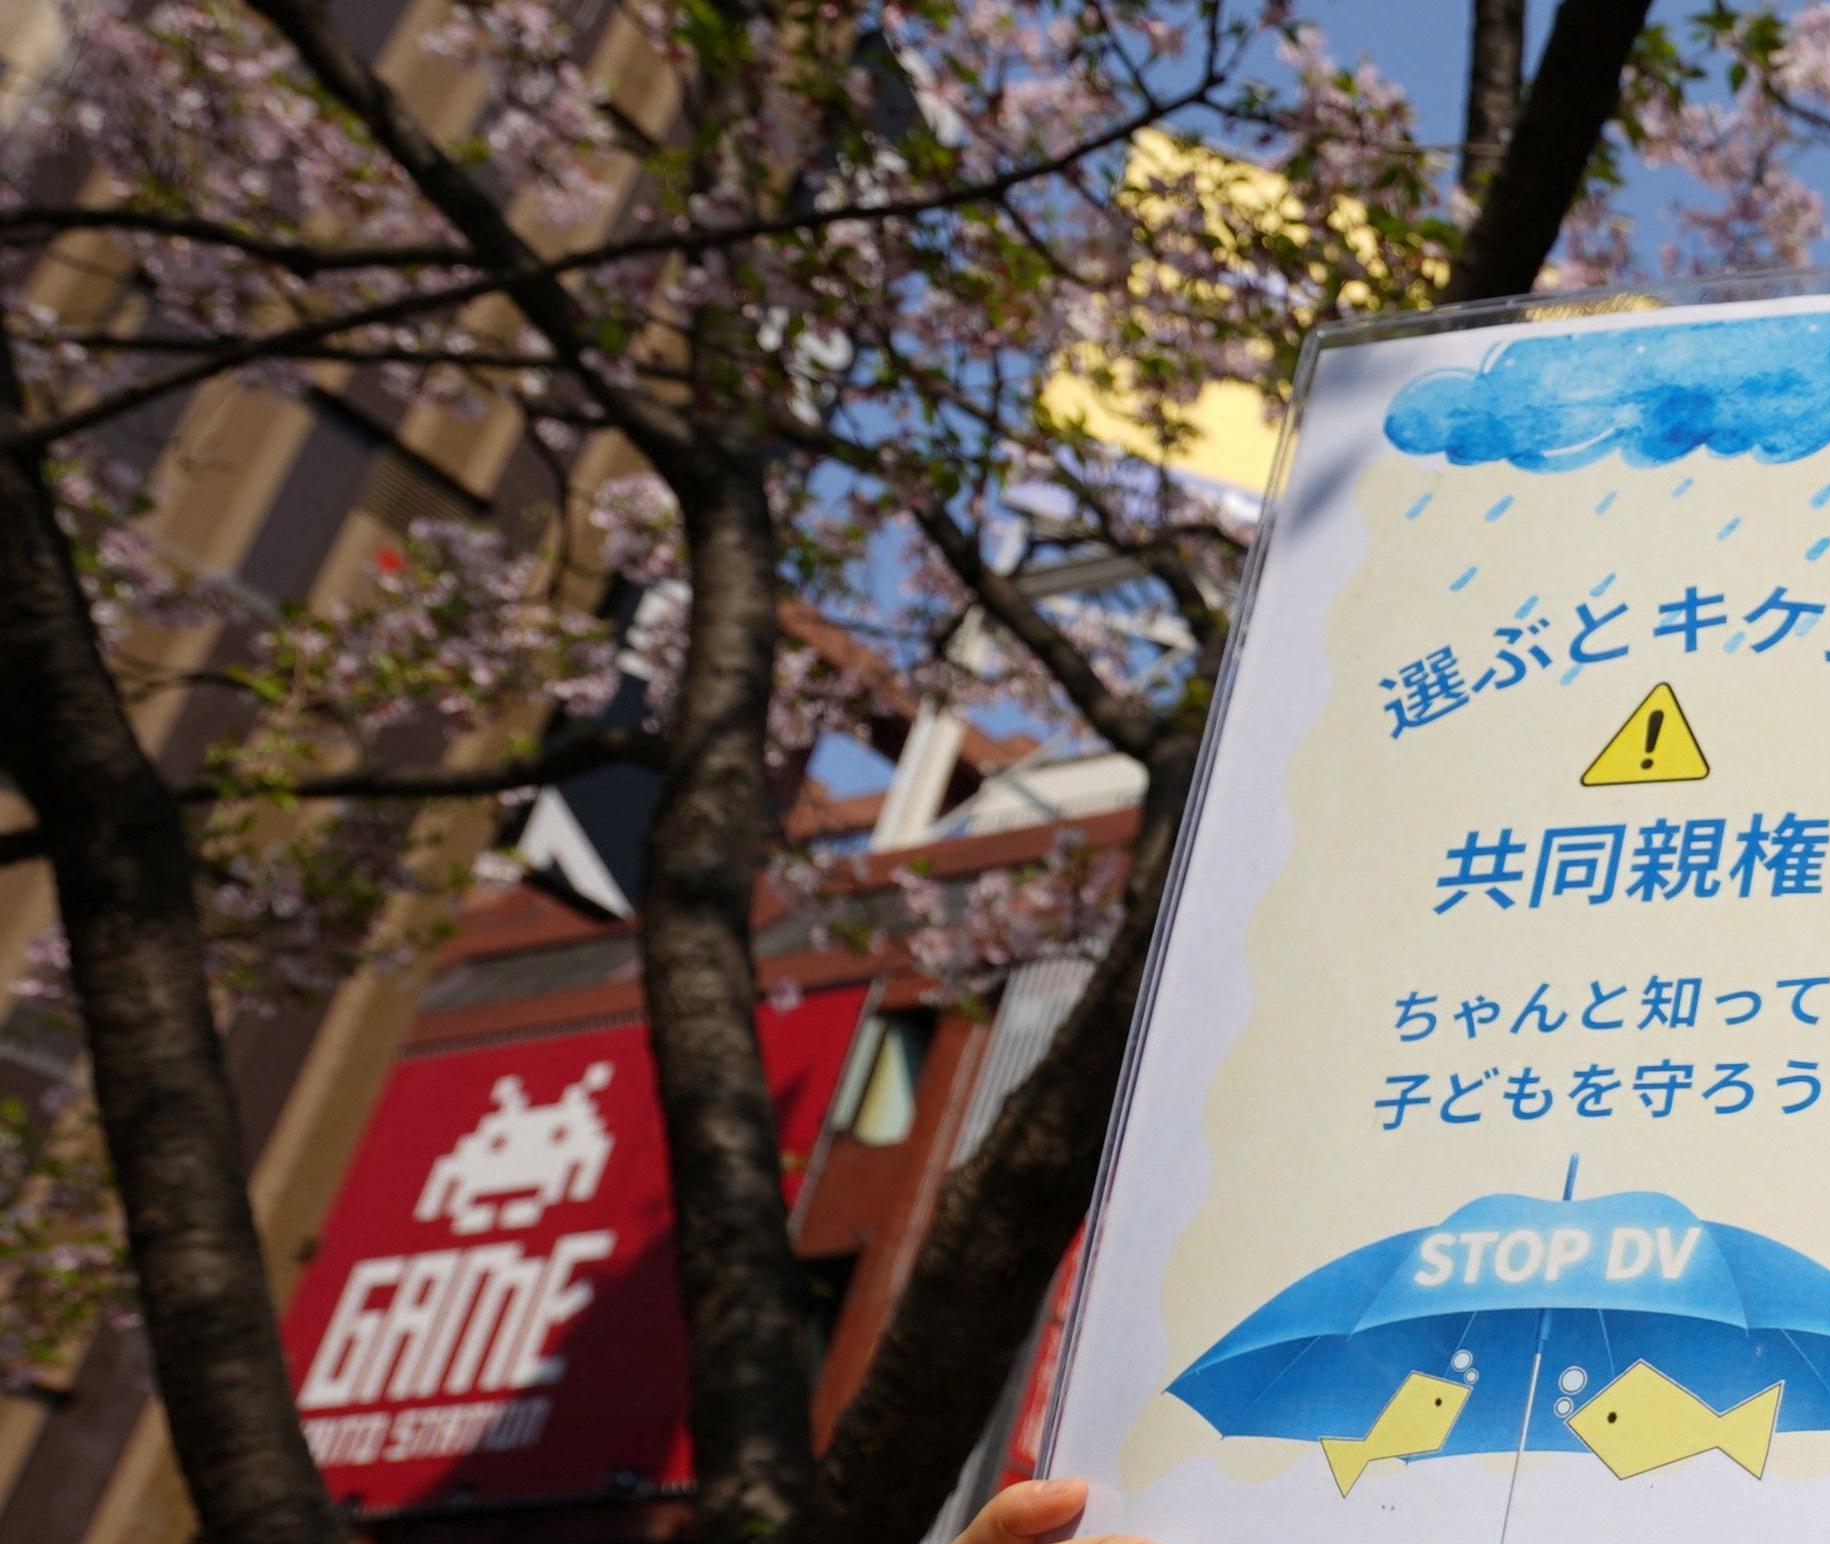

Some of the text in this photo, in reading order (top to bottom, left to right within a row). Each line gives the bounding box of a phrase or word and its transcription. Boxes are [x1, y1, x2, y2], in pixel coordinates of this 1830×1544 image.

[1433, 811, 1830, 914] 共同親権
[1374, 1059, 1822, 1130] 子どもを守ろう
[1413, 1225, 1703, 1288] STOP DV
[296, 1228, 618, 1412] GAME
